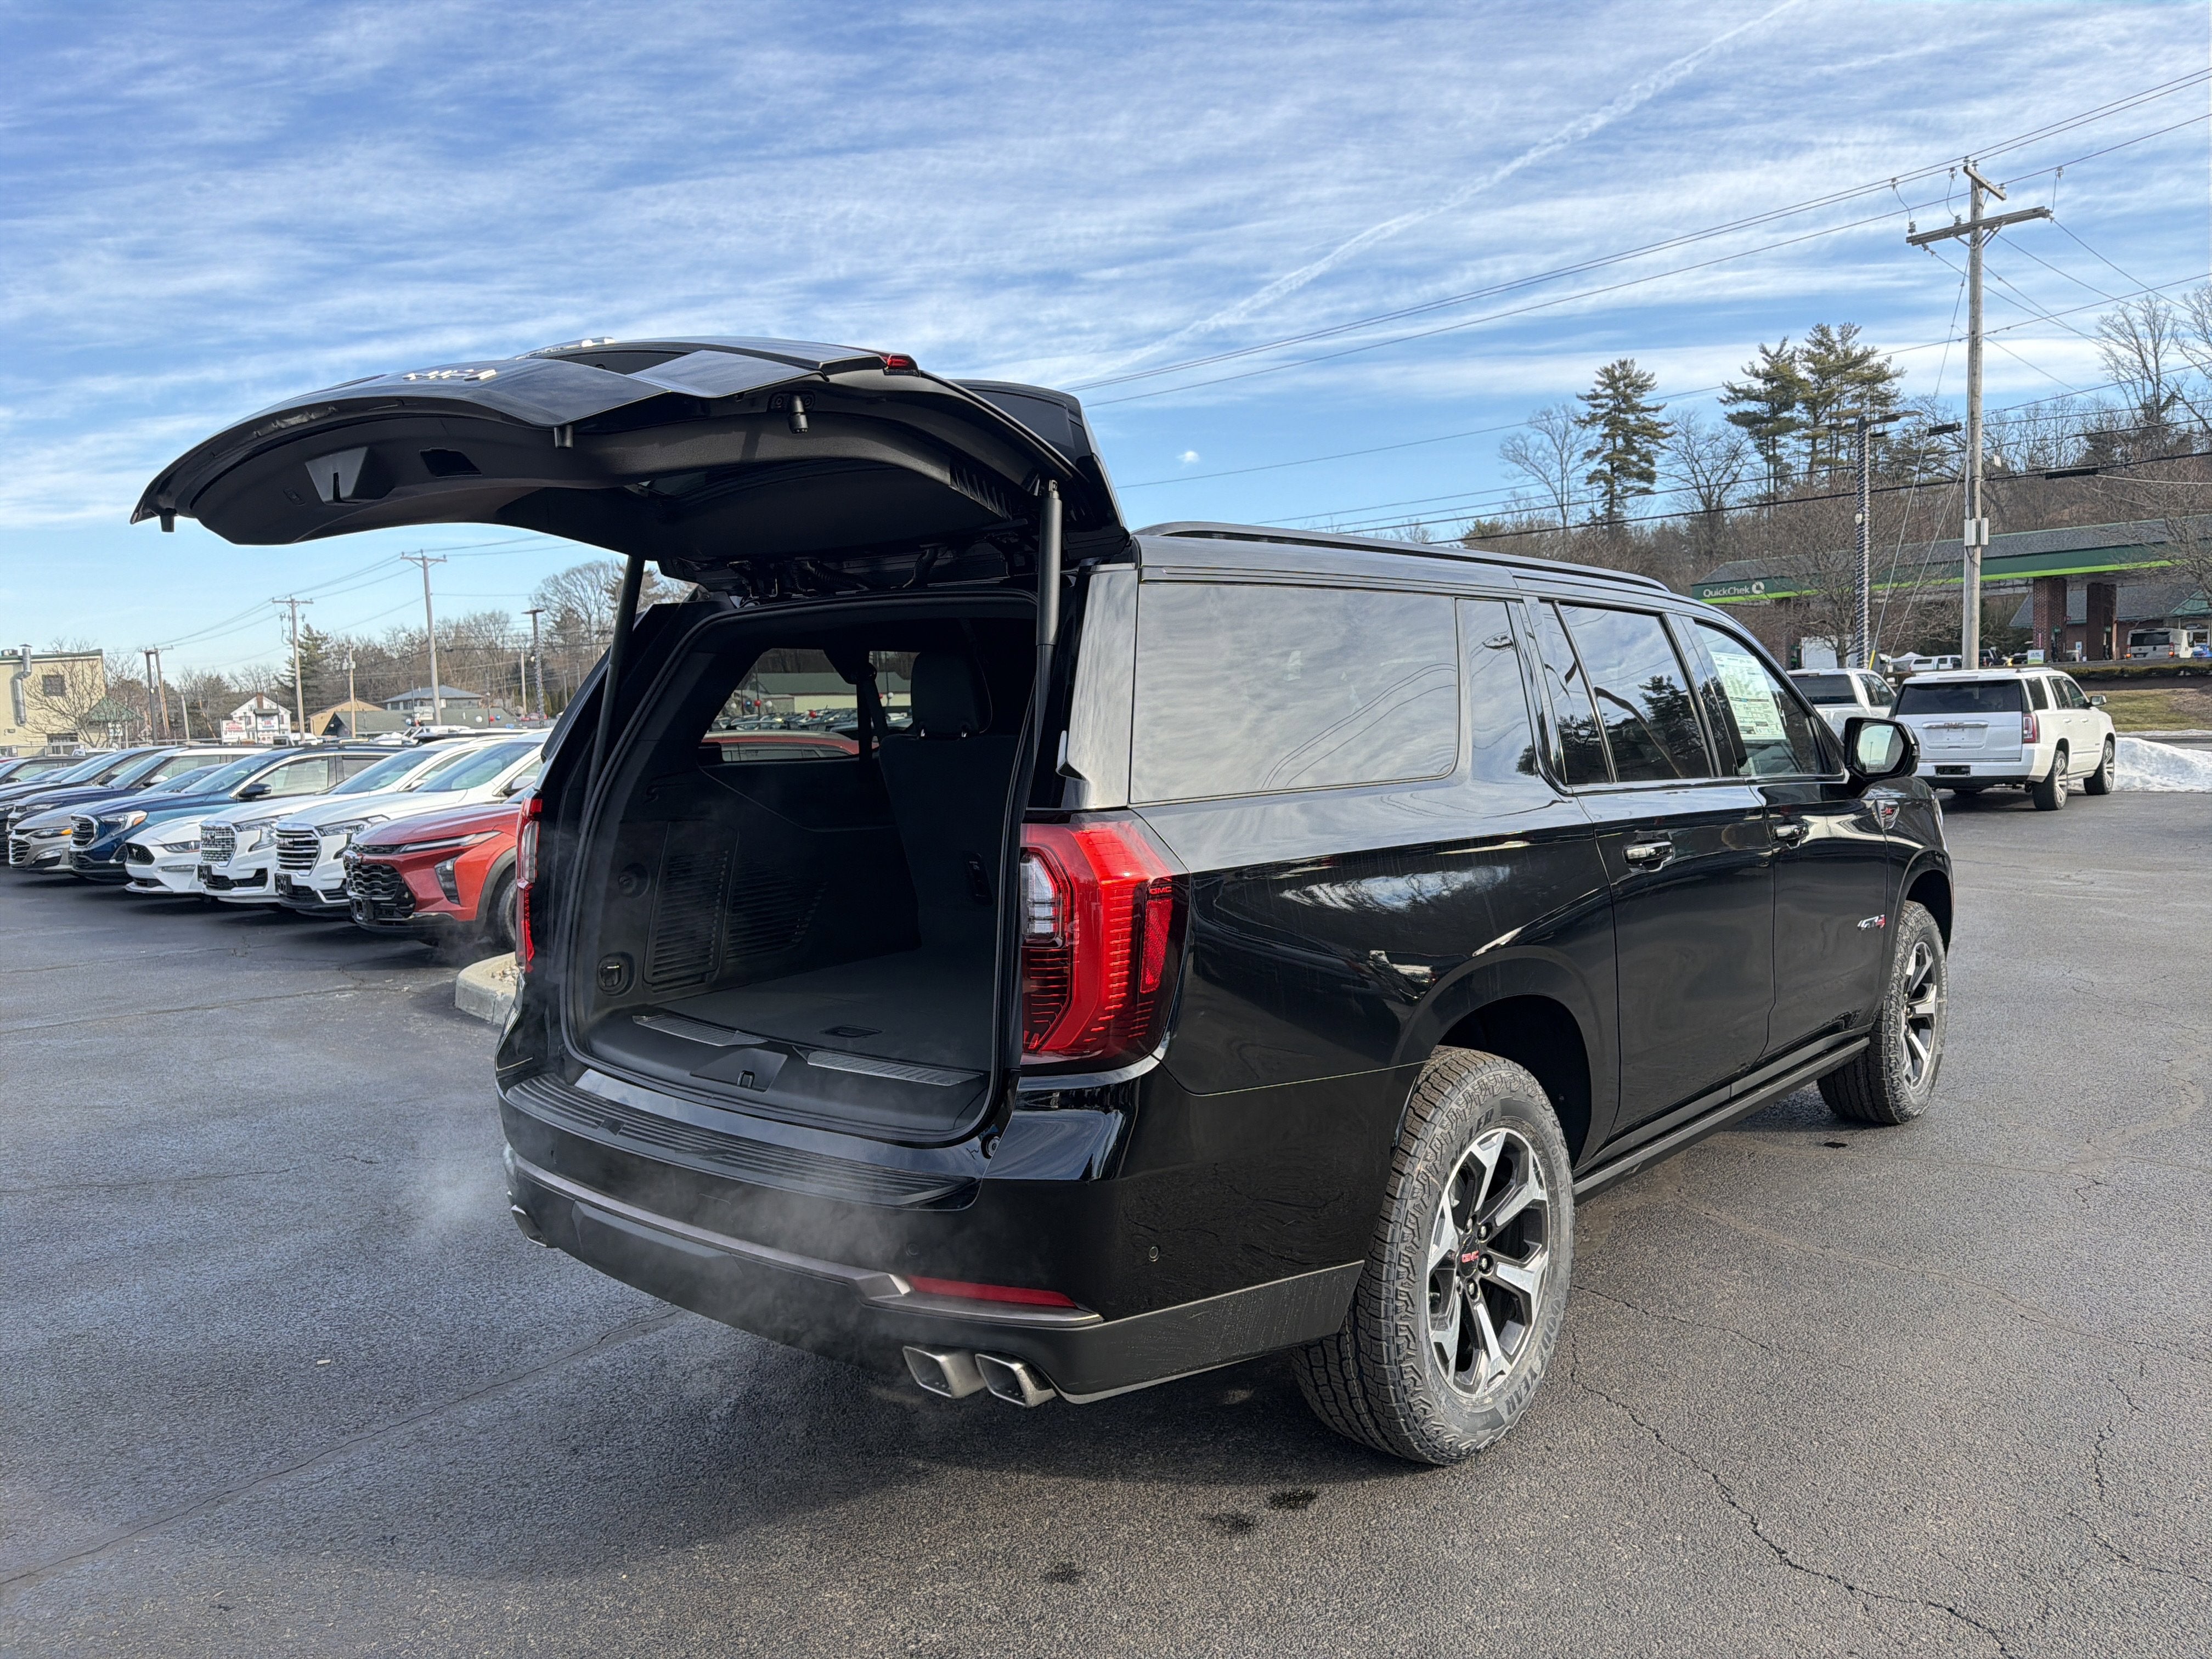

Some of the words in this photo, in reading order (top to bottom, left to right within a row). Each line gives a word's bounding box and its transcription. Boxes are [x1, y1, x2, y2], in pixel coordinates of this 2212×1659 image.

[1703, 585, 1750, 597] QuickChek
[1149, 886, 1172, 894] GMC
[1462, 1250, 1479, 1263] GMC
